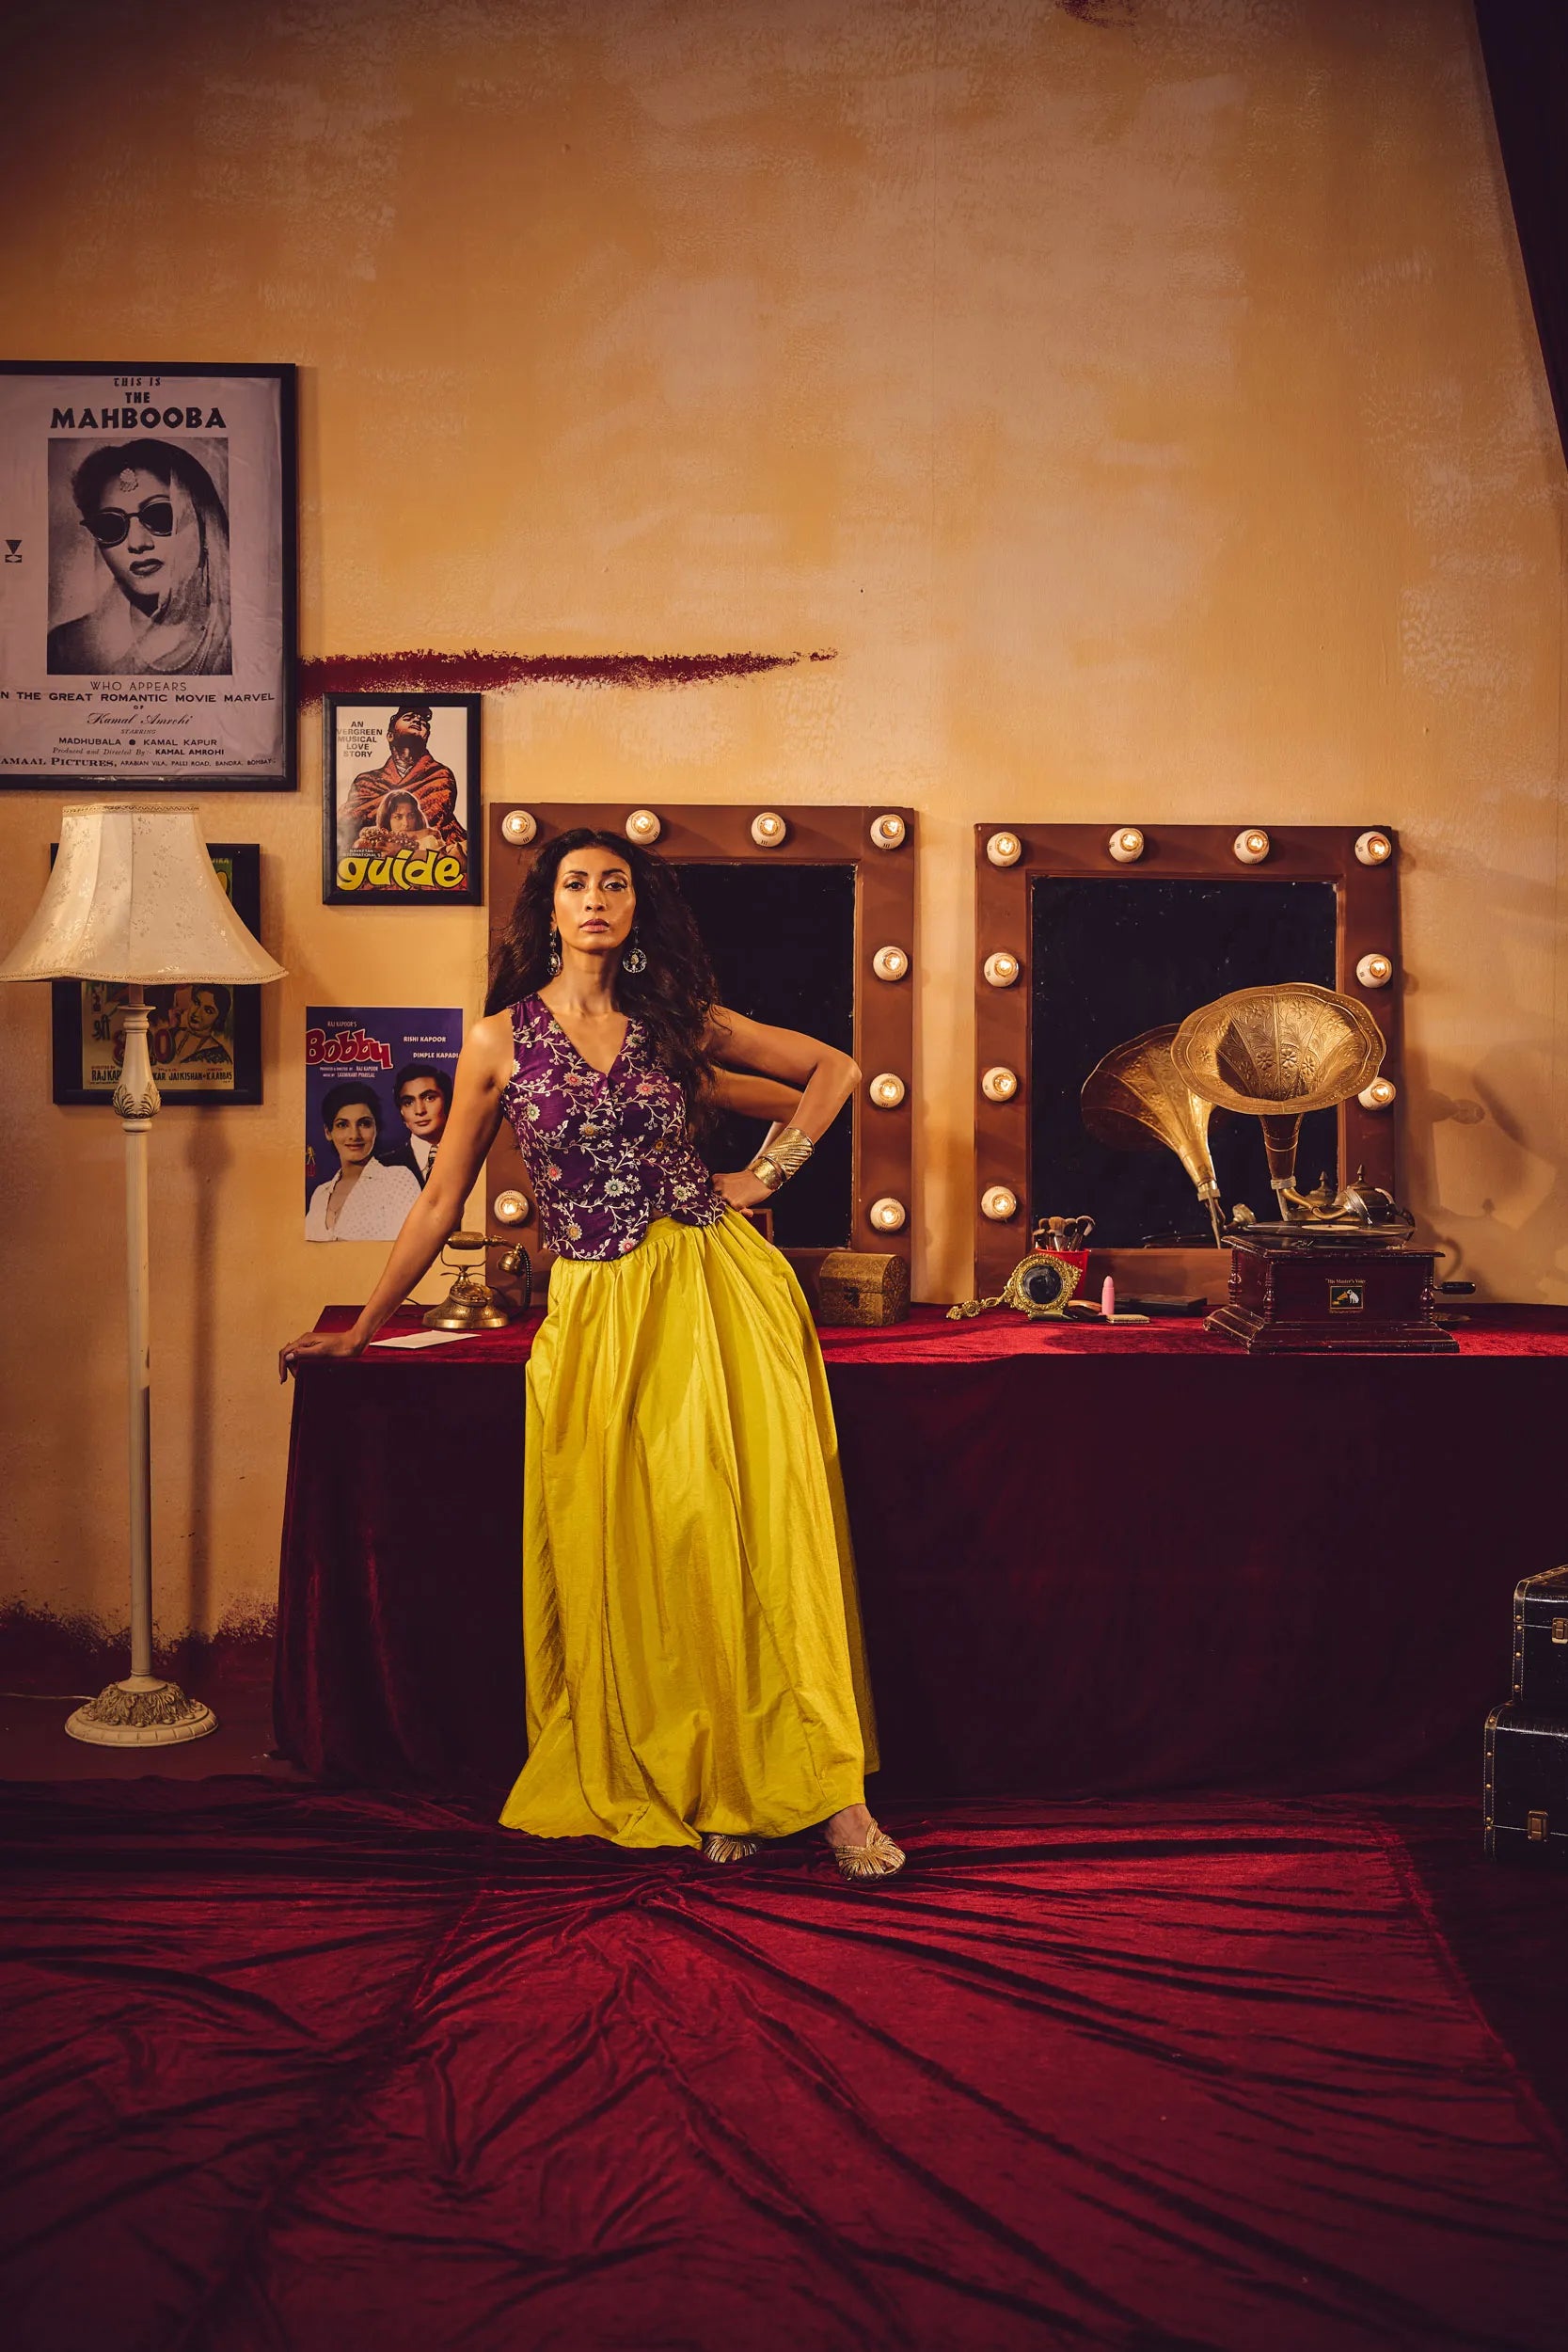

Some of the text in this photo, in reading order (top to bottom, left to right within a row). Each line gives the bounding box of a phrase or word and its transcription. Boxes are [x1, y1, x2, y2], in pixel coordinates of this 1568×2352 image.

[114, 377, 161, 387] THIS IS
[125, 391, 150, 404] THE
[50, 406, 227, 429] MAHBOOBA
[90, 681, 187, 691] WHO APPEARS
[49, 692, 92, 701] GREAT
[101, 693, 167, 702] ROMANTIC
[176, 694, 216, 703] MOVIE
[224, 693, 275, 703] MARVEL
[87, 713, 193, 725] Kamal Amrohi
[58, 737, 121, 746] MADHUBALA
[337, 848, 466, 891] guide
[306, 1028, 393, 1070] Bobby
[91, 1070, 106, 1081] RAJ
[168, 1072, 203, 1081] JAIKISHAN
